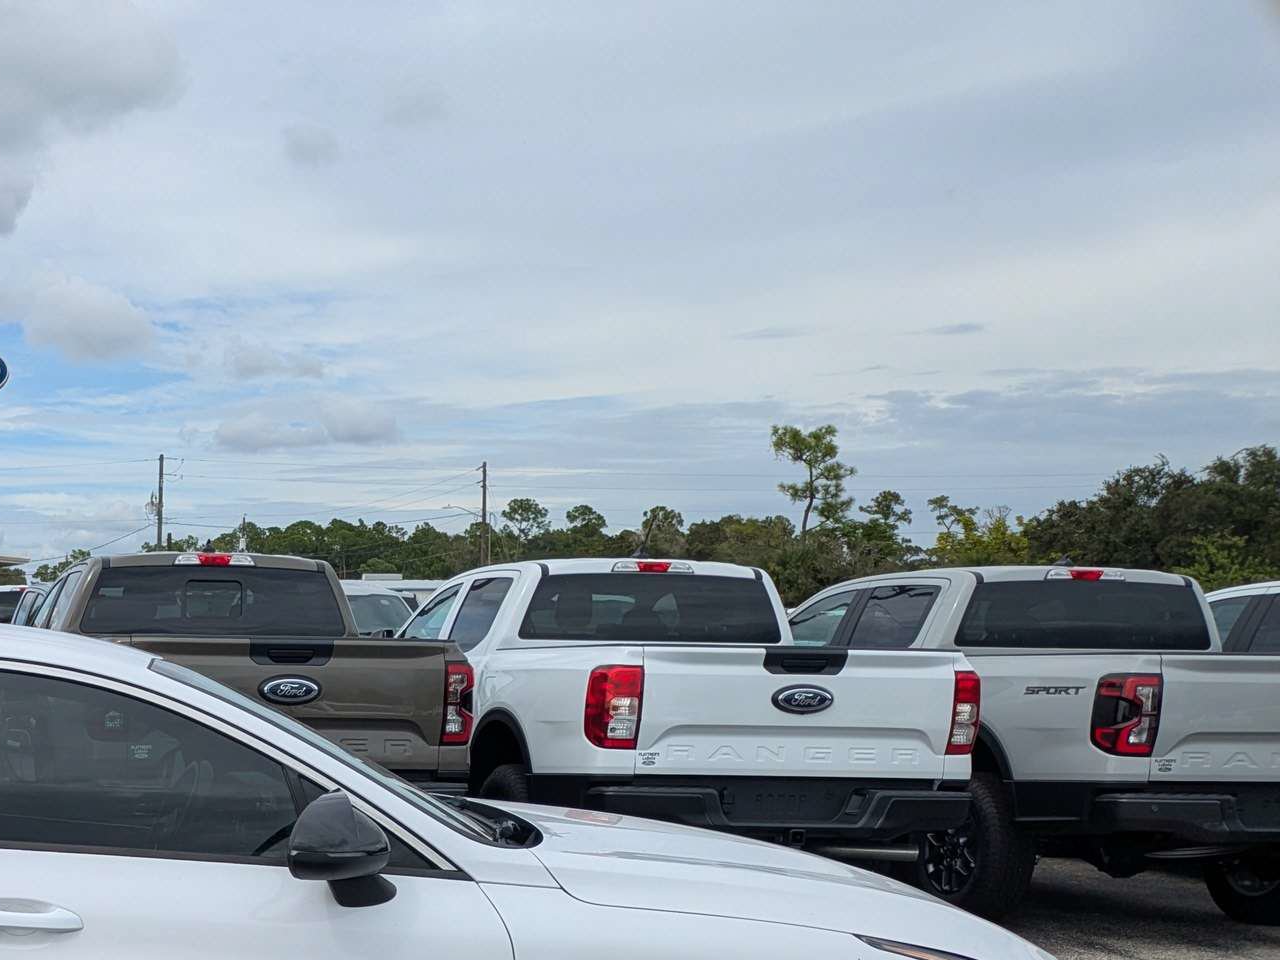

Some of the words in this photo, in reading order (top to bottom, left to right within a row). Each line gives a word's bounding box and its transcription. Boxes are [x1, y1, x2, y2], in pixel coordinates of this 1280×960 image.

[276, 683, 306, 696] Ford
[1023, 686, 1087, 695] SPORT
[791, 692, 821, 705] Ford
[666, 744, 919, 764] RANGER
